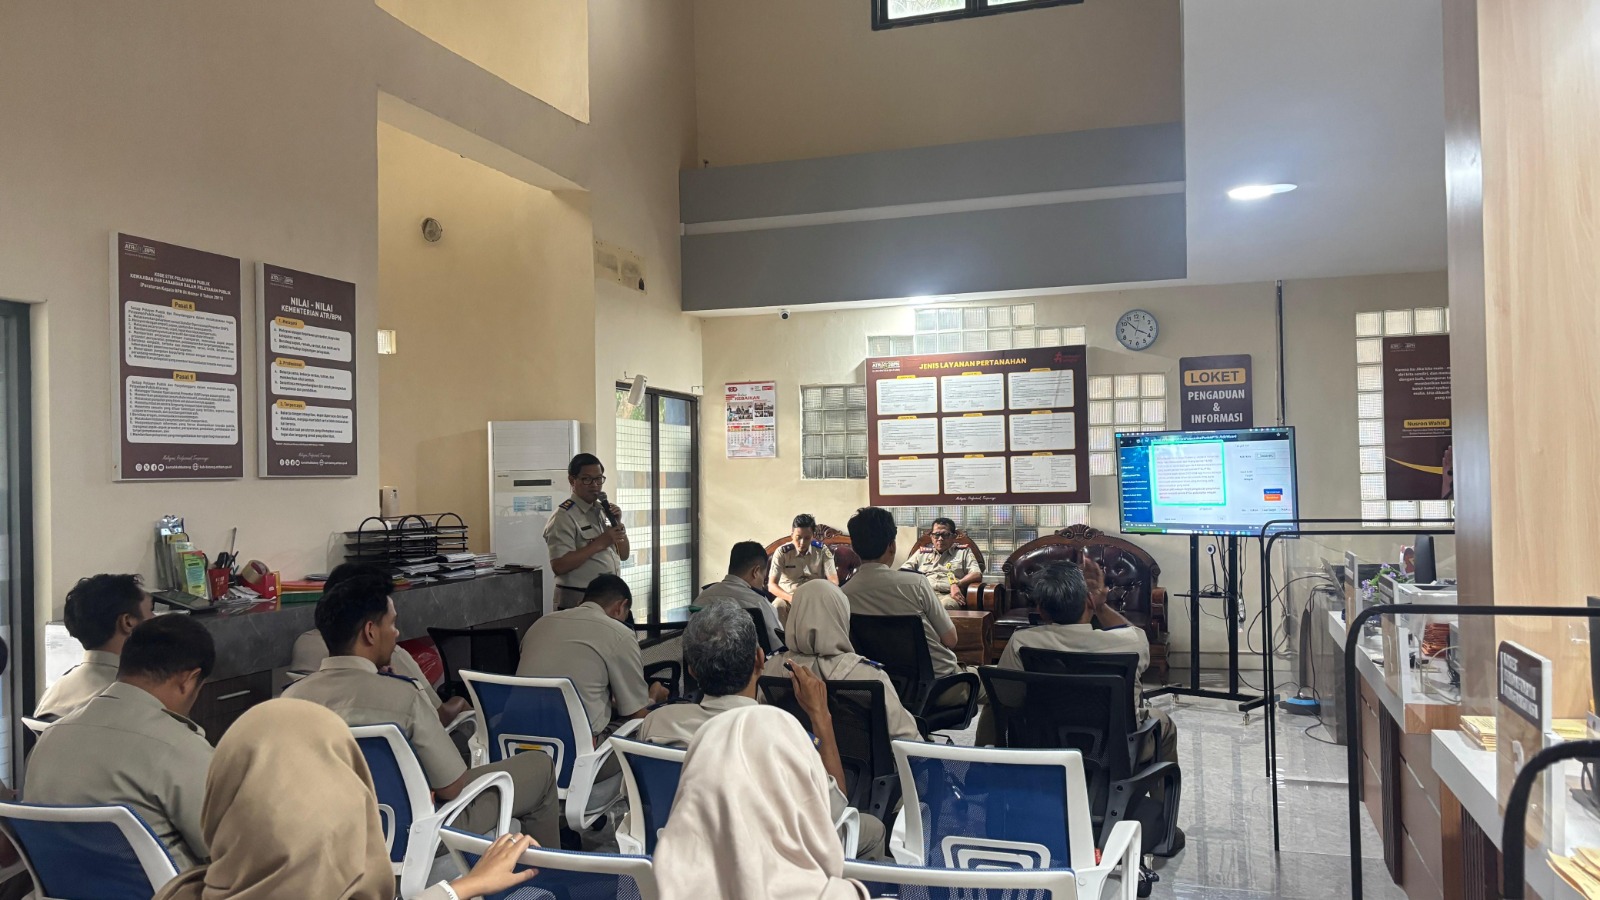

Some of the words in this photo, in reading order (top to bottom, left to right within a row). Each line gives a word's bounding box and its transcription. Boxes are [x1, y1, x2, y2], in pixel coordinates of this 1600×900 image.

[290, 297, 309, 308] NILAI
[315, 301, 333, 312] NILAI
[281, 305, 319, 317] KEMENTERIAN
[320, 312, 342, 322] ATR/BPN
[919, 361, 939, 370] JENIS
[939, 360, 975, 369] LAYANAN
[976, 357, 1027, 367] PERTANAHAN
[1191, 371, 1239, 383] LOKET
[1188, 389, 1245, 400] PENGADUAN
[1213, 402, 1220, 411] &
[1191, 413, 1243, 423] INFORMASI
